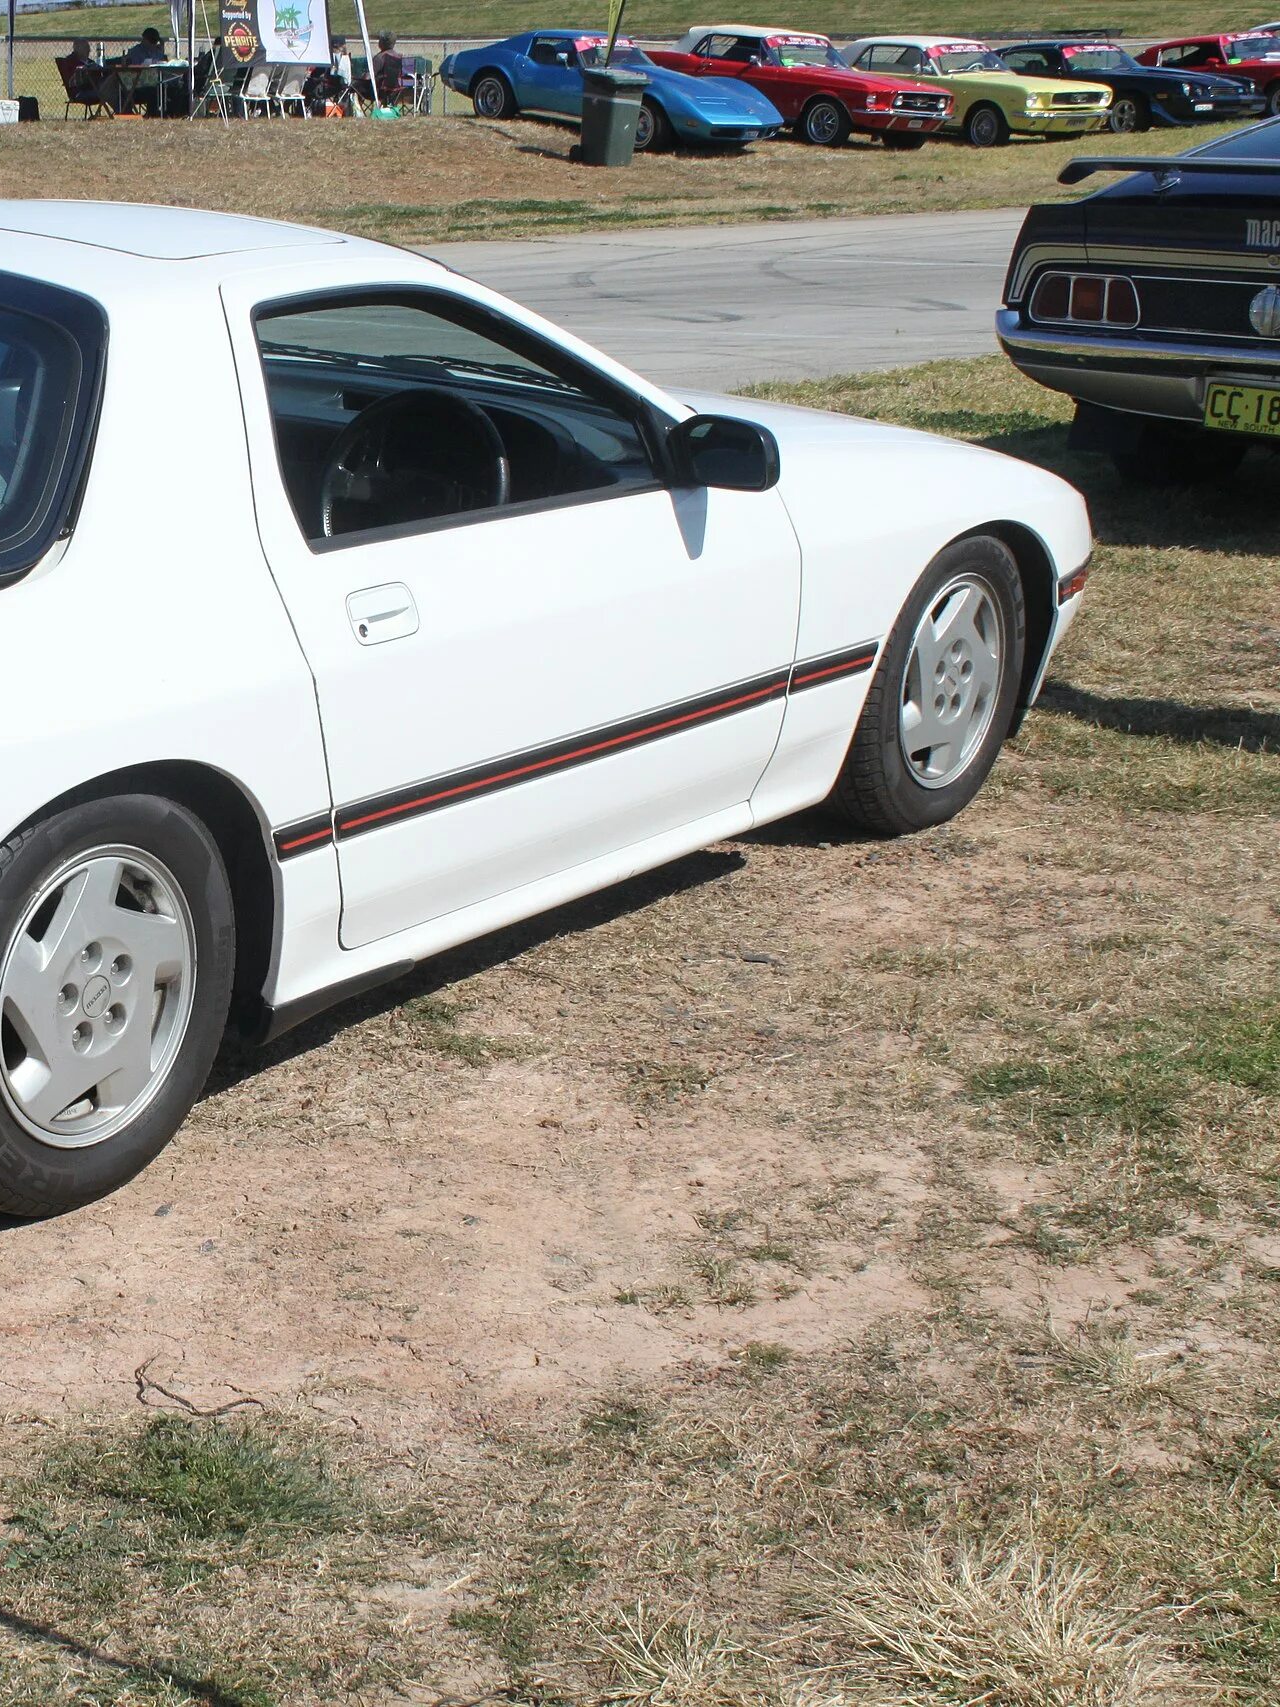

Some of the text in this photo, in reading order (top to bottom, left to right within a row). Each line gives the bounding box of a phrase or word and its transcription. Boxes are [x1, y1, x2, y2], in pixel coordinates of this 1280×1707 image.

[222, 10, 244, 20] Supported
[224, 35, 259, 47] PENRITE
[1246, 219, 1280, 247] mac
[1218, 420, 1275, 433] NEW SOUTH
